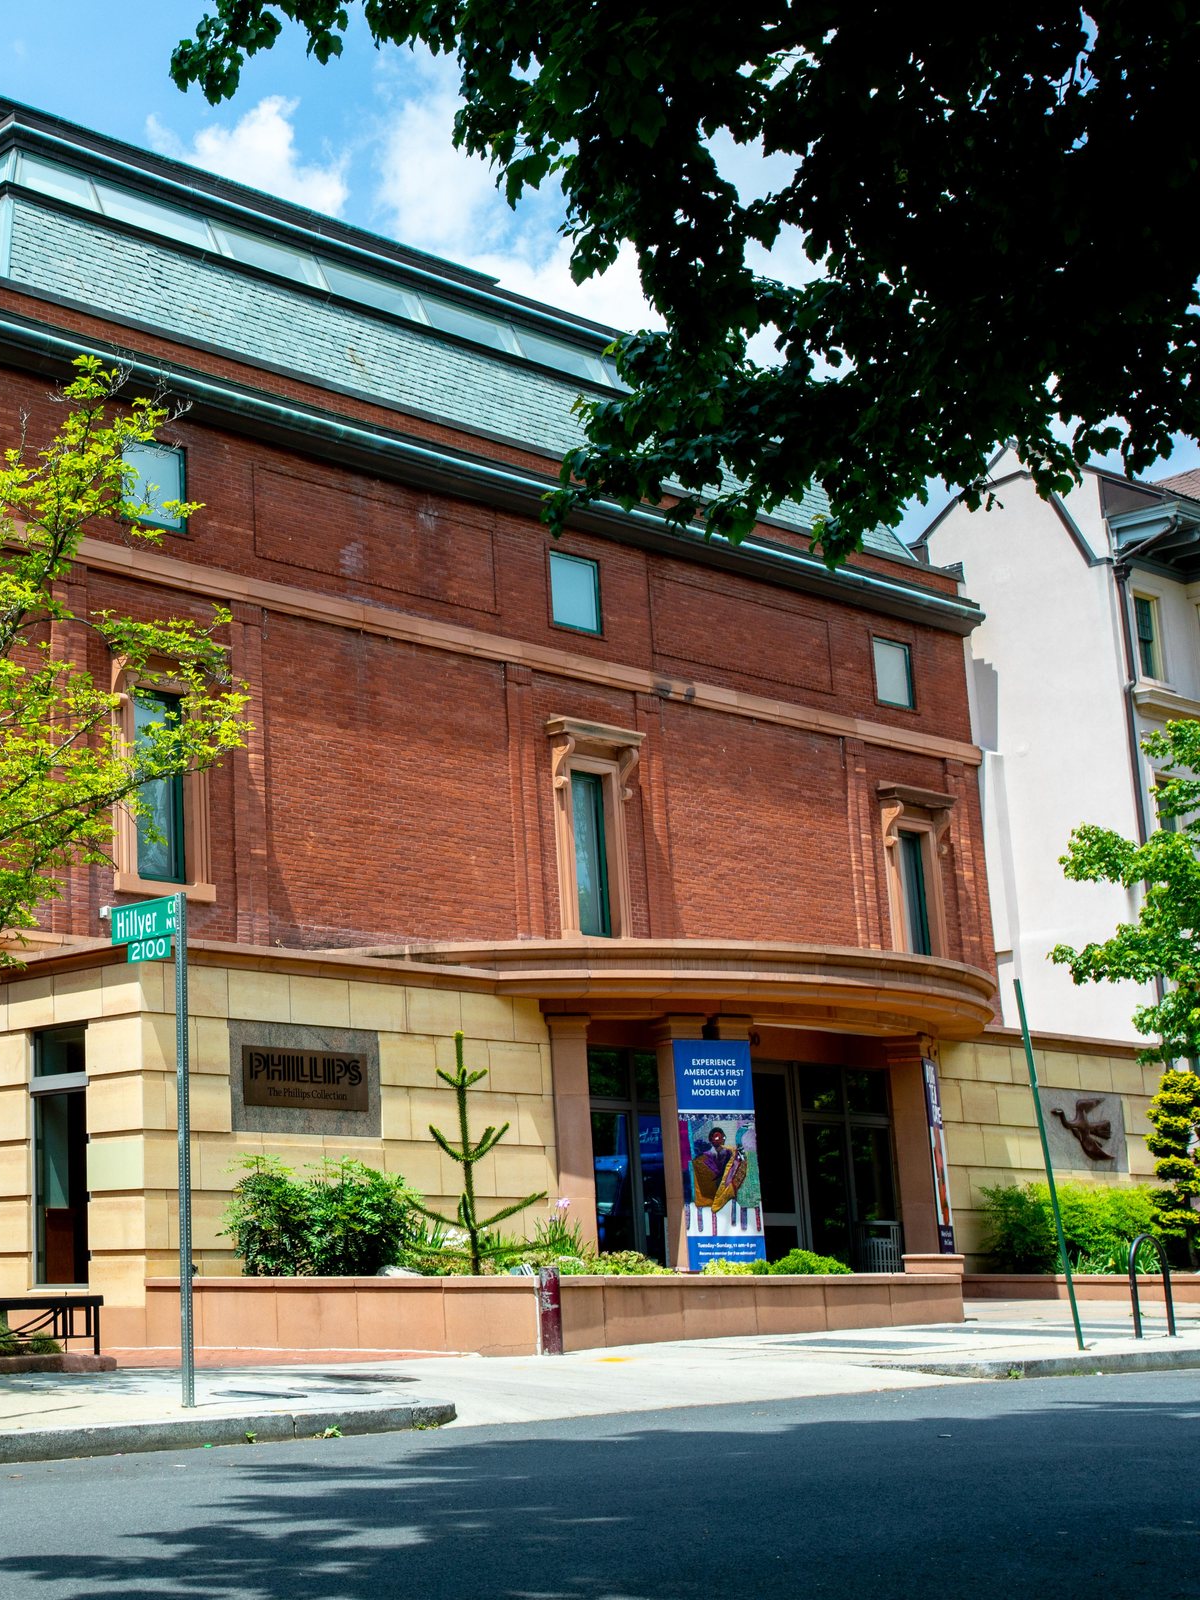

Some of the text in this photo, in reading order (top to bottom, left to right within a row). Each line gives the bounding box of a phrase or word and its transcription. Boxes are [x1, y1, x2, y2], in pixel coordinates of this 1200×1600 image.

[116, 909, 157, 940] Hillyer
[131, 939, 166, 961] 2100
[249, 1052, 362, 1086] PHILLIPS
[691, 1059, 736, 1067] EXPERIENCE
[683, 1068, 744, 1077] AMERICA'S FIRST
[693, 1079, 738, 1087] MUSEUM OF
[267, 1086, 348, 1101] The Phillips Collection
[691, 1089, 741, 1097] MODERN ART
